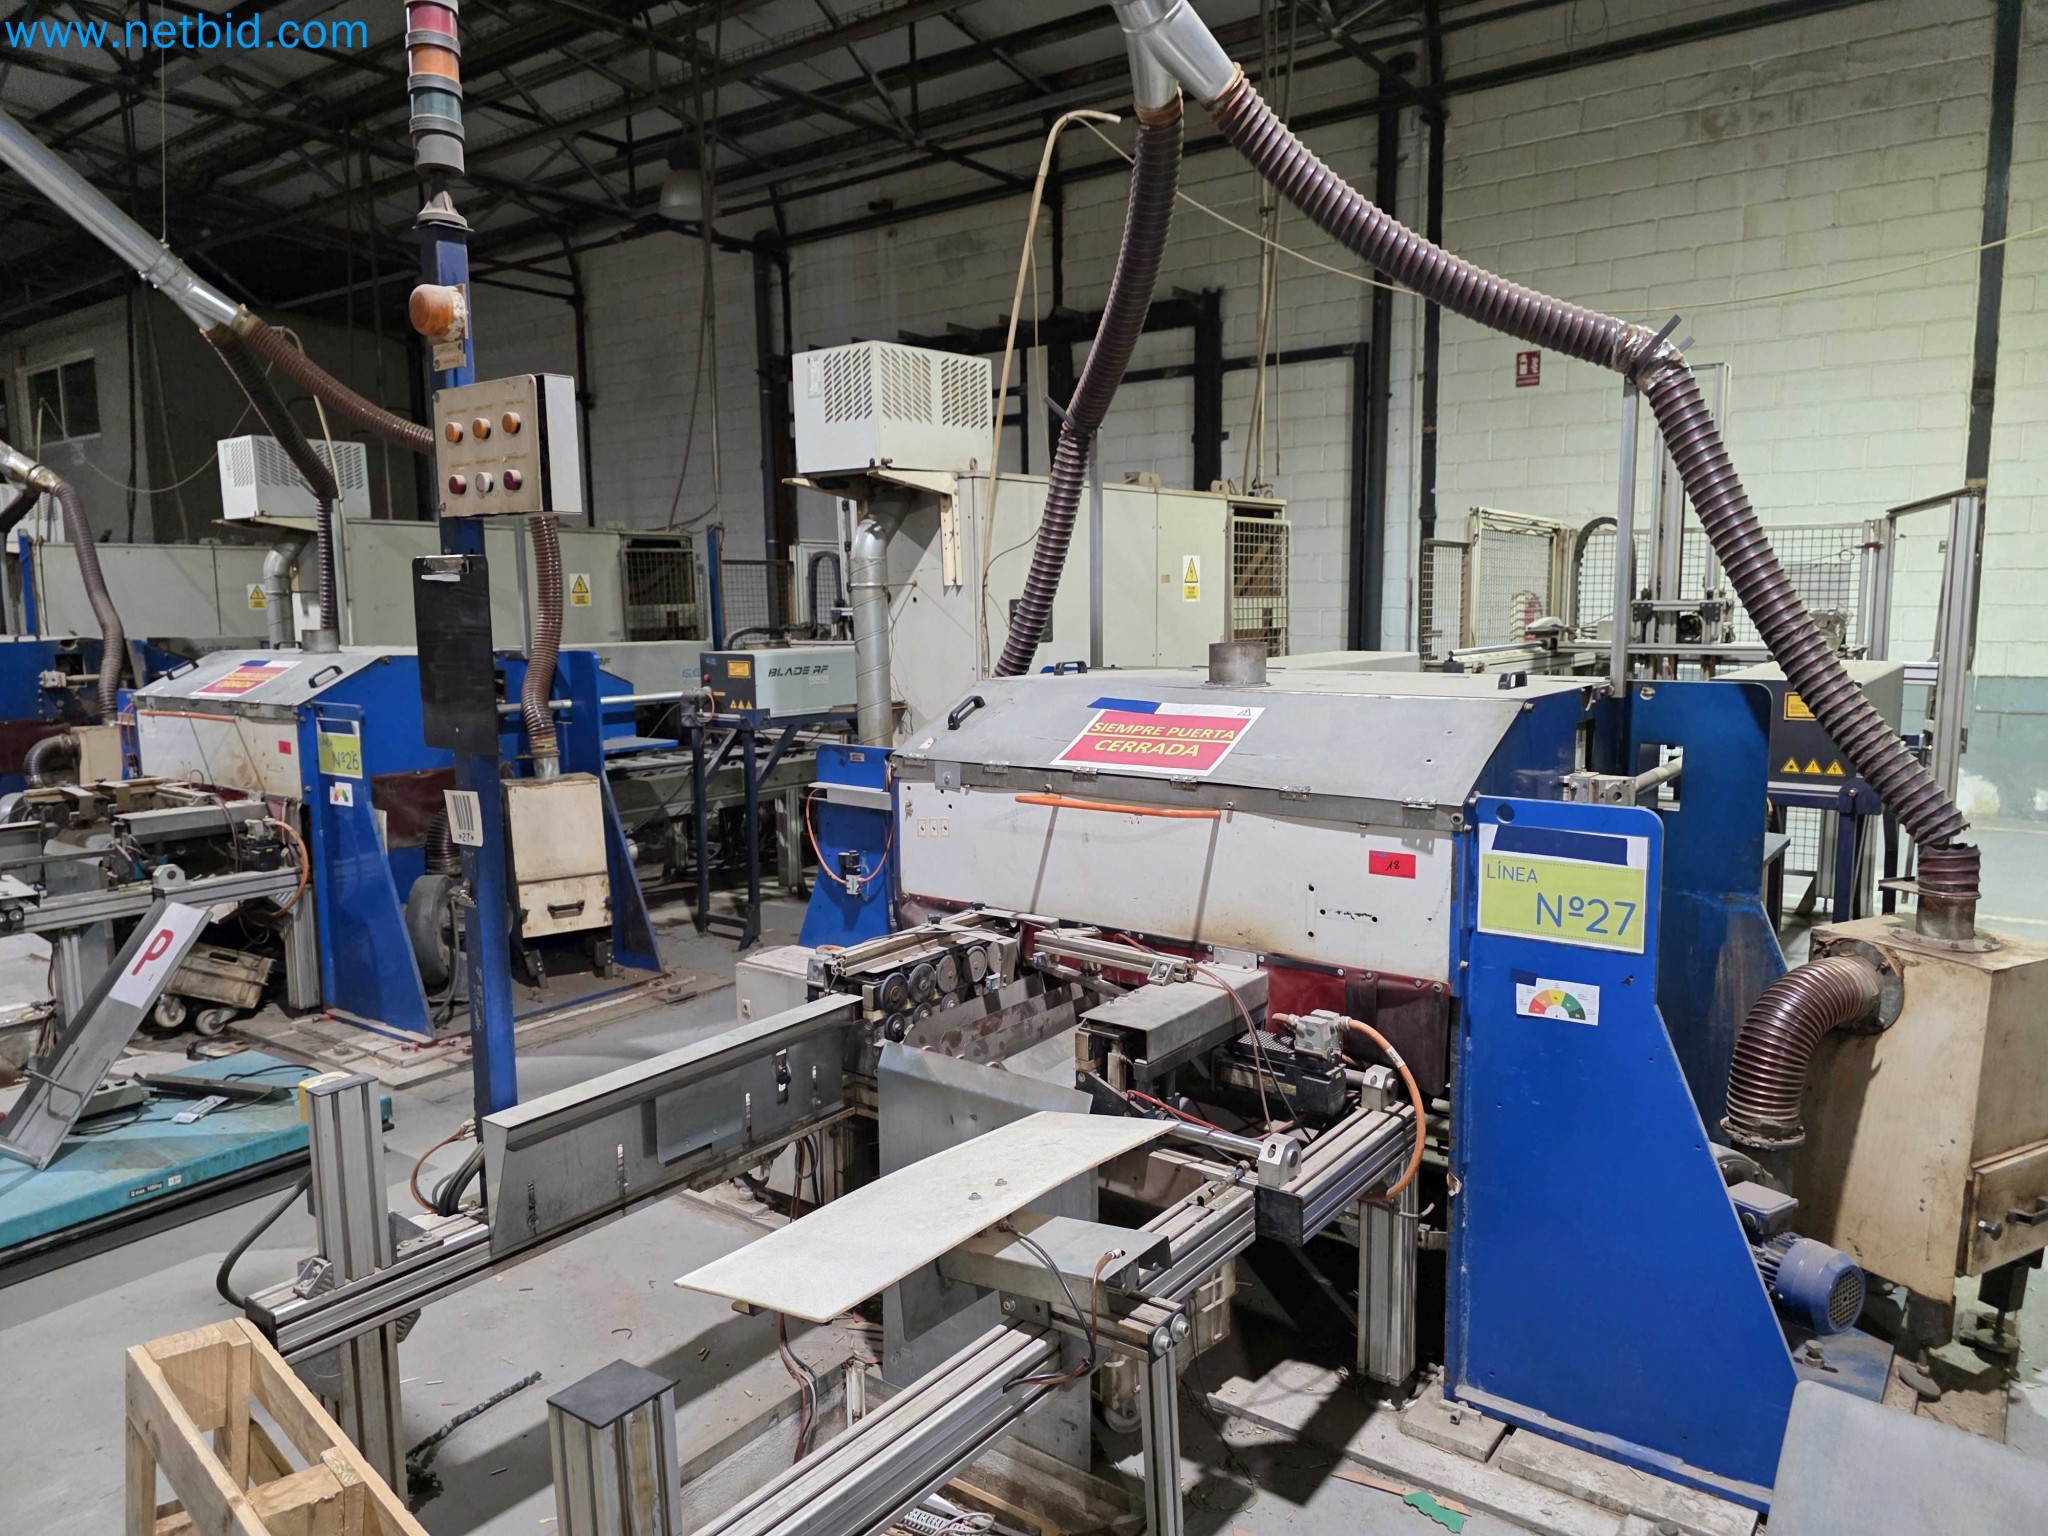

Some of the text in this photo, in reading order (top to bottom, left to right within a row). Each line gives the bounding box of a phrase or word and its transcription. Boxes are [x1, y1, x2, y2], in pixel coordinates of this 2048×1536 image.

[768, 665, 829, 677] BLADE RF
[1092, 723, 1236, 739] SIEMPRE PUERTA
[1094, 740, 1200, 757] CERRADA
[1487, 861, 1538, 883] LÍNEA
[1536, 892, 1636, 936] Nº27
[131, 928, 174, 976] P
